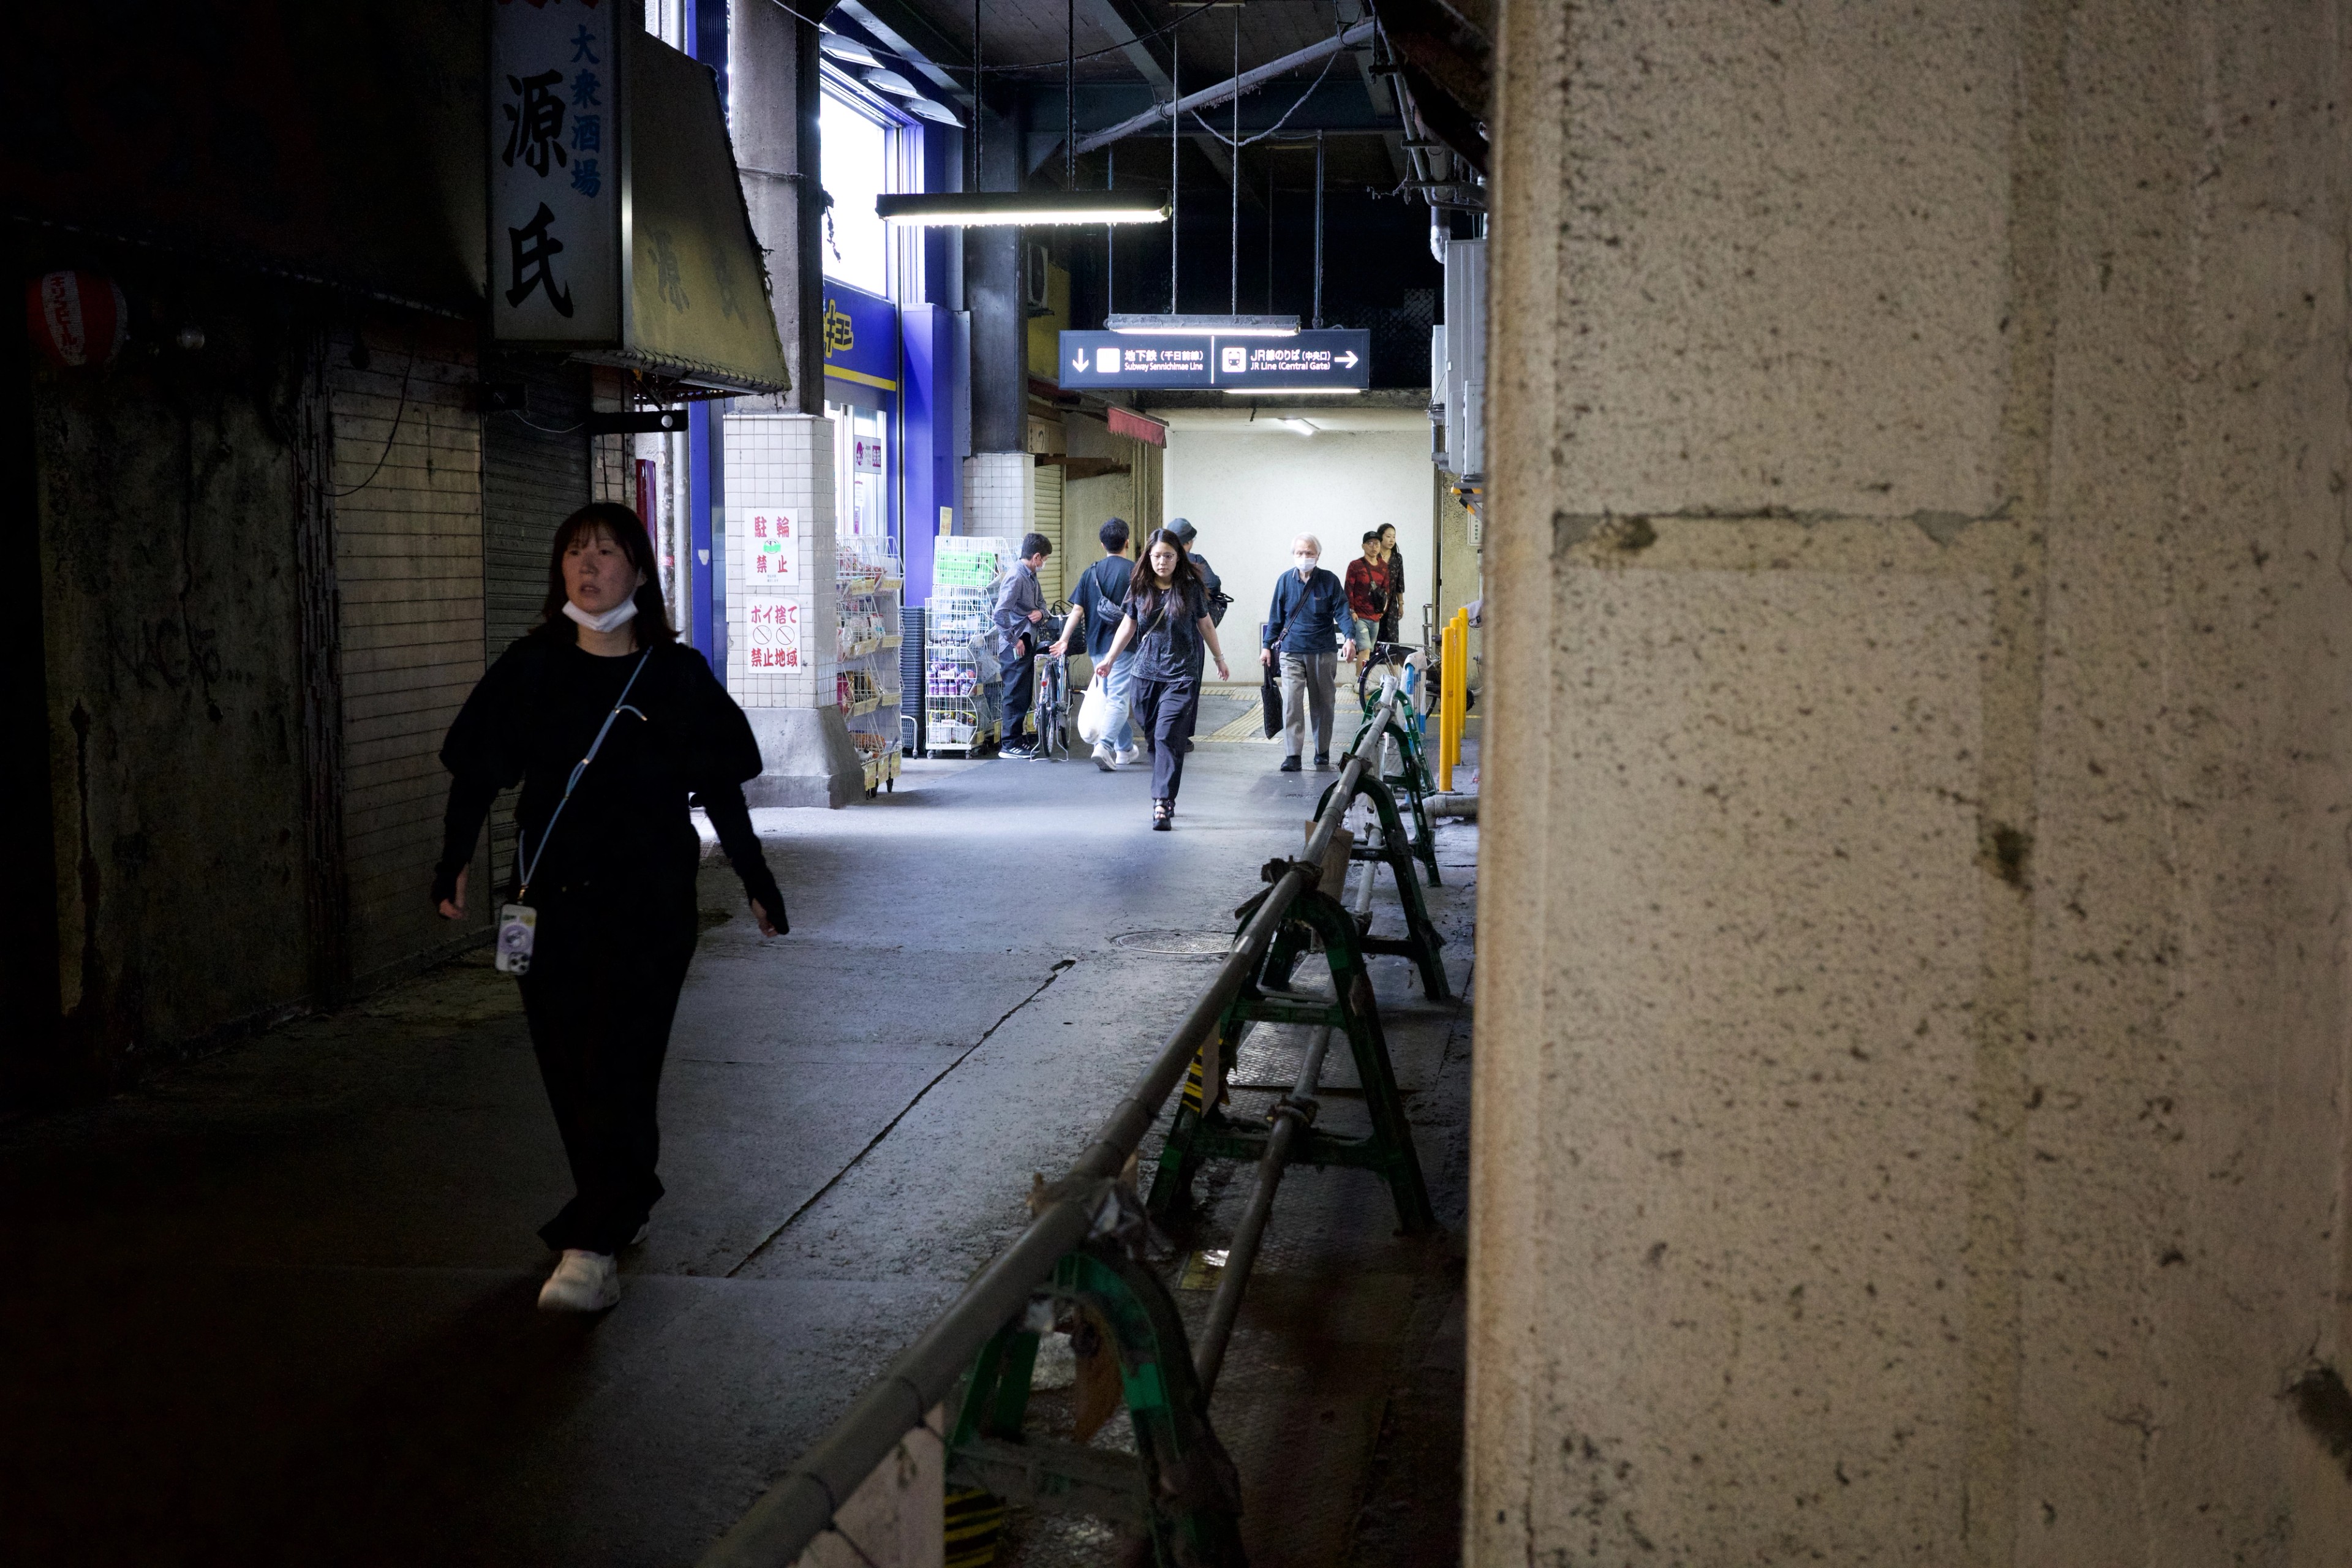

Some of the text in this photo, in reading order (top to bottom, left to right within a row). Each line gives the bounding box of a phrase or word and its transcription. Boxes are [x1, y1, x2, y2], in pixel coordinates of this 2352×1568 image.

[571, 24, 601, 198] 大衆酒場
[502, 69, 574, 318] 源氏
[1125, 361, 1204, 372] Subway Sennichimae Line
[1278, 361, 1308, 370] (Central
[1310, 361, 1330, 370] Gate)
[755, 516, 789, 538] 駐輪
[756, 555, 788, 573] 禁止
[751, 604, 797, 624] ポイ捨て
[751, 648, 797, 667] 禁止地域
